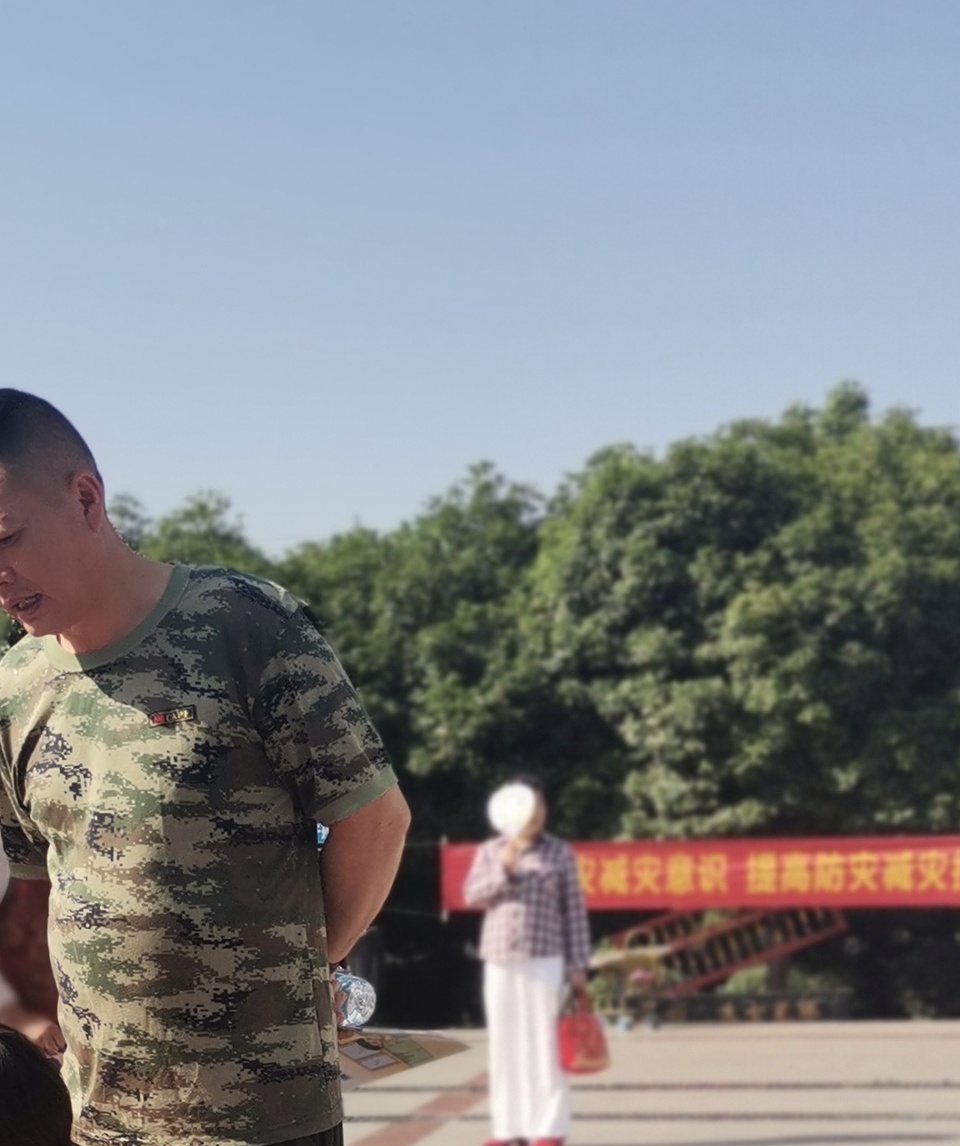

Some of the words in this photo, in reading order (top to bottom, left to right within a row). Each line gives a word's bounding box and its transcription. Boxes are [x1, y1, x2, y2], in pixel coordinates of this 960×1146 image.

[746, 850, 960, 894] 提高防灾减灾
